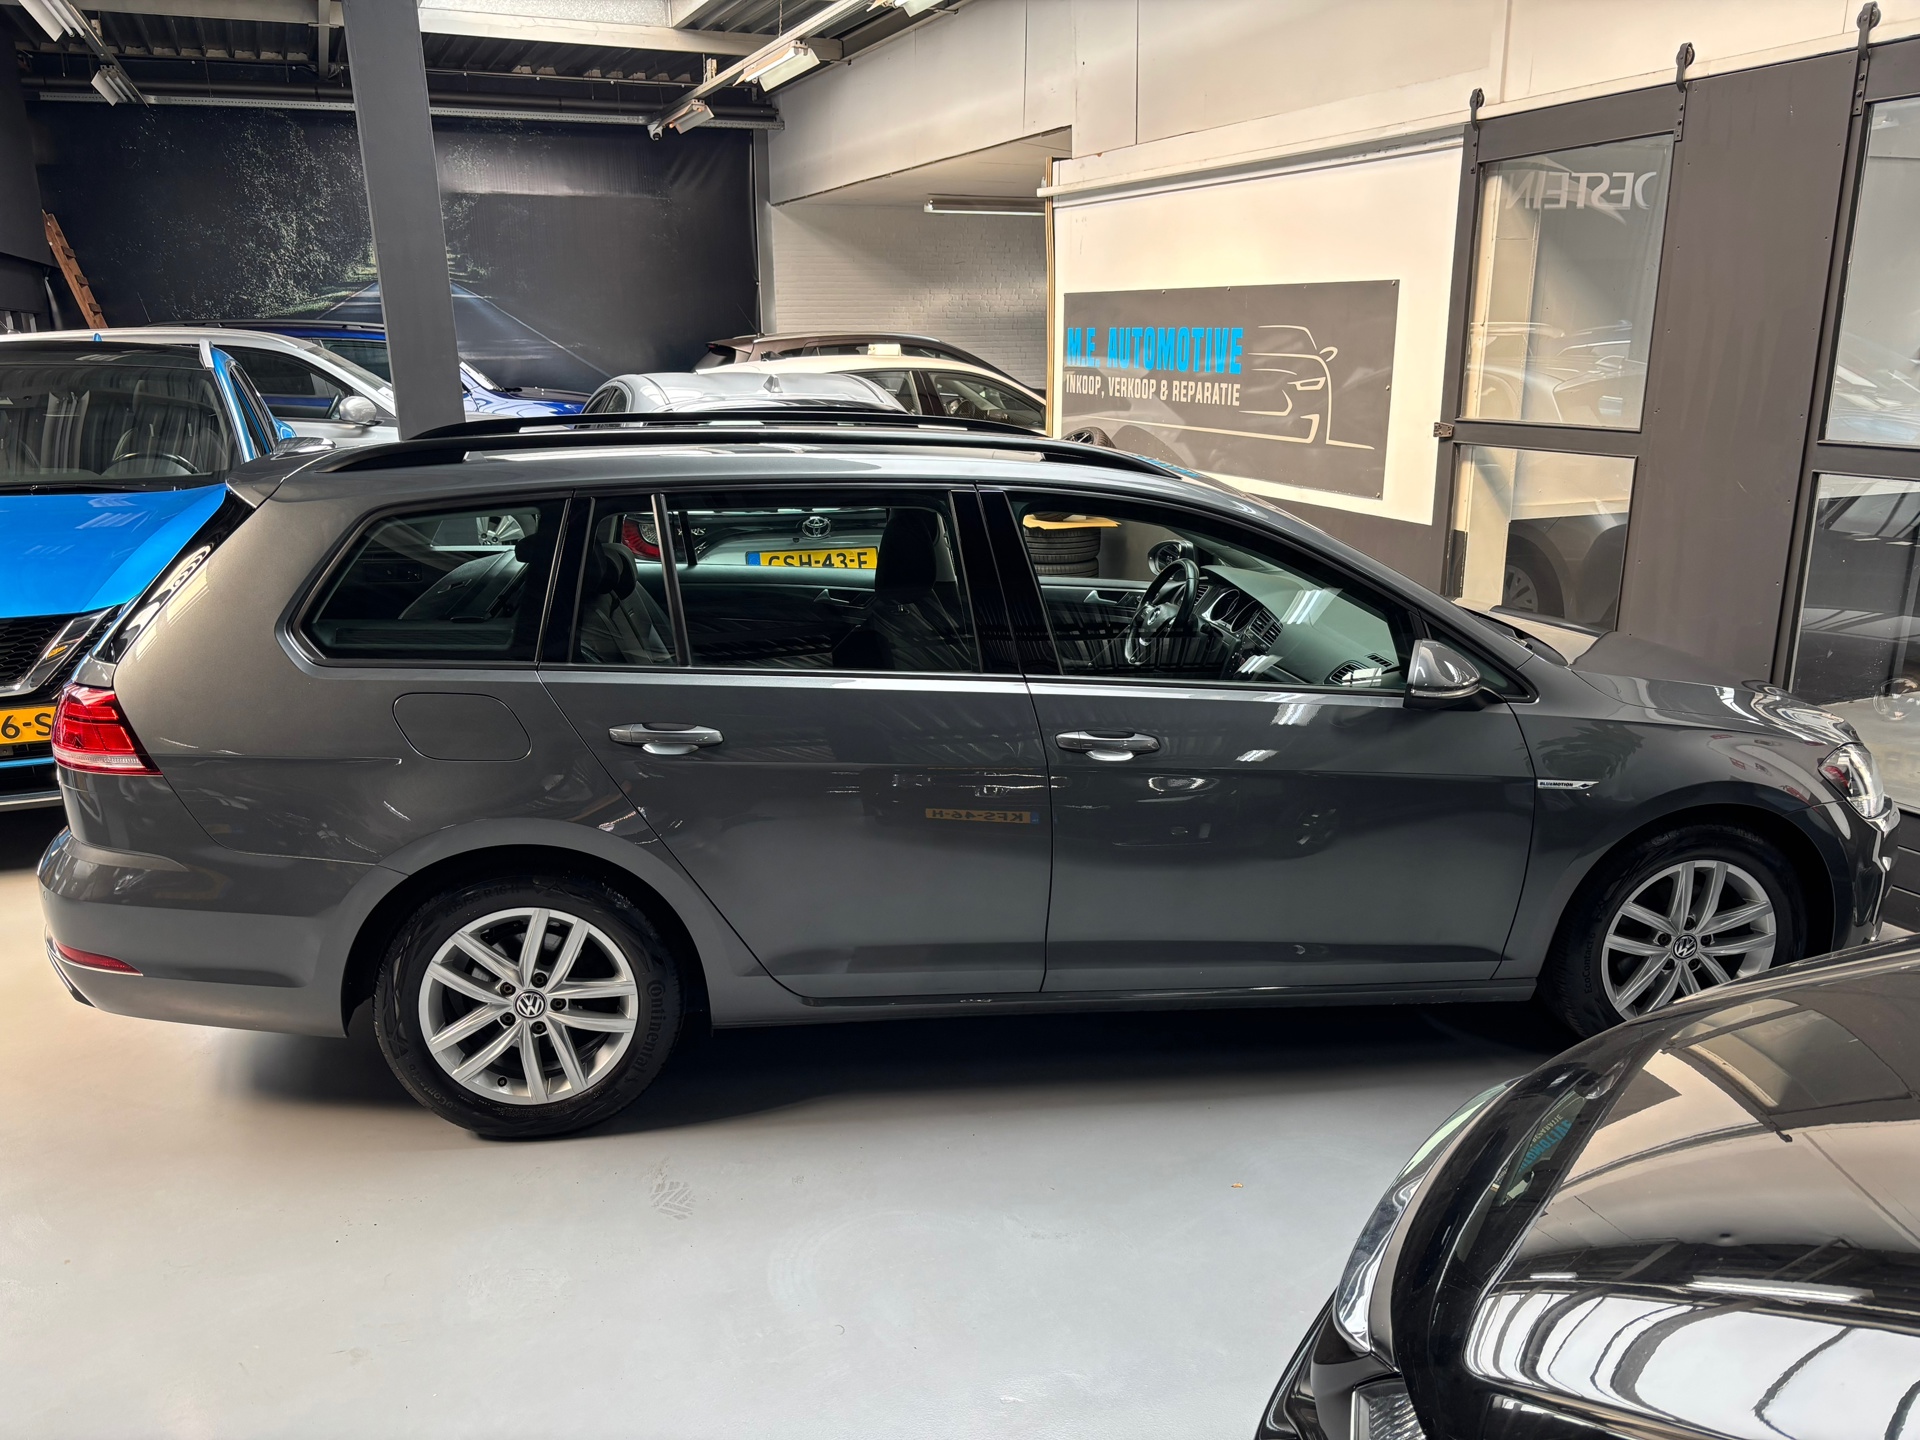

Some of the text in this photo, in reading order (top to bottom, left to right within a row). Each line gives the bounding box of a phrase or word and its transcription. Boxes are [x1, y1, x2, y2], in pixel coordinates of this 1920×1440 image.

[1067, 326, 1244, 375] M.E. AUTOMOTIVE
[1066, 374, 1241, 406] INKOOP, VERKOOP & REPARATIE
[631, 979, 666, 1073] Continental
